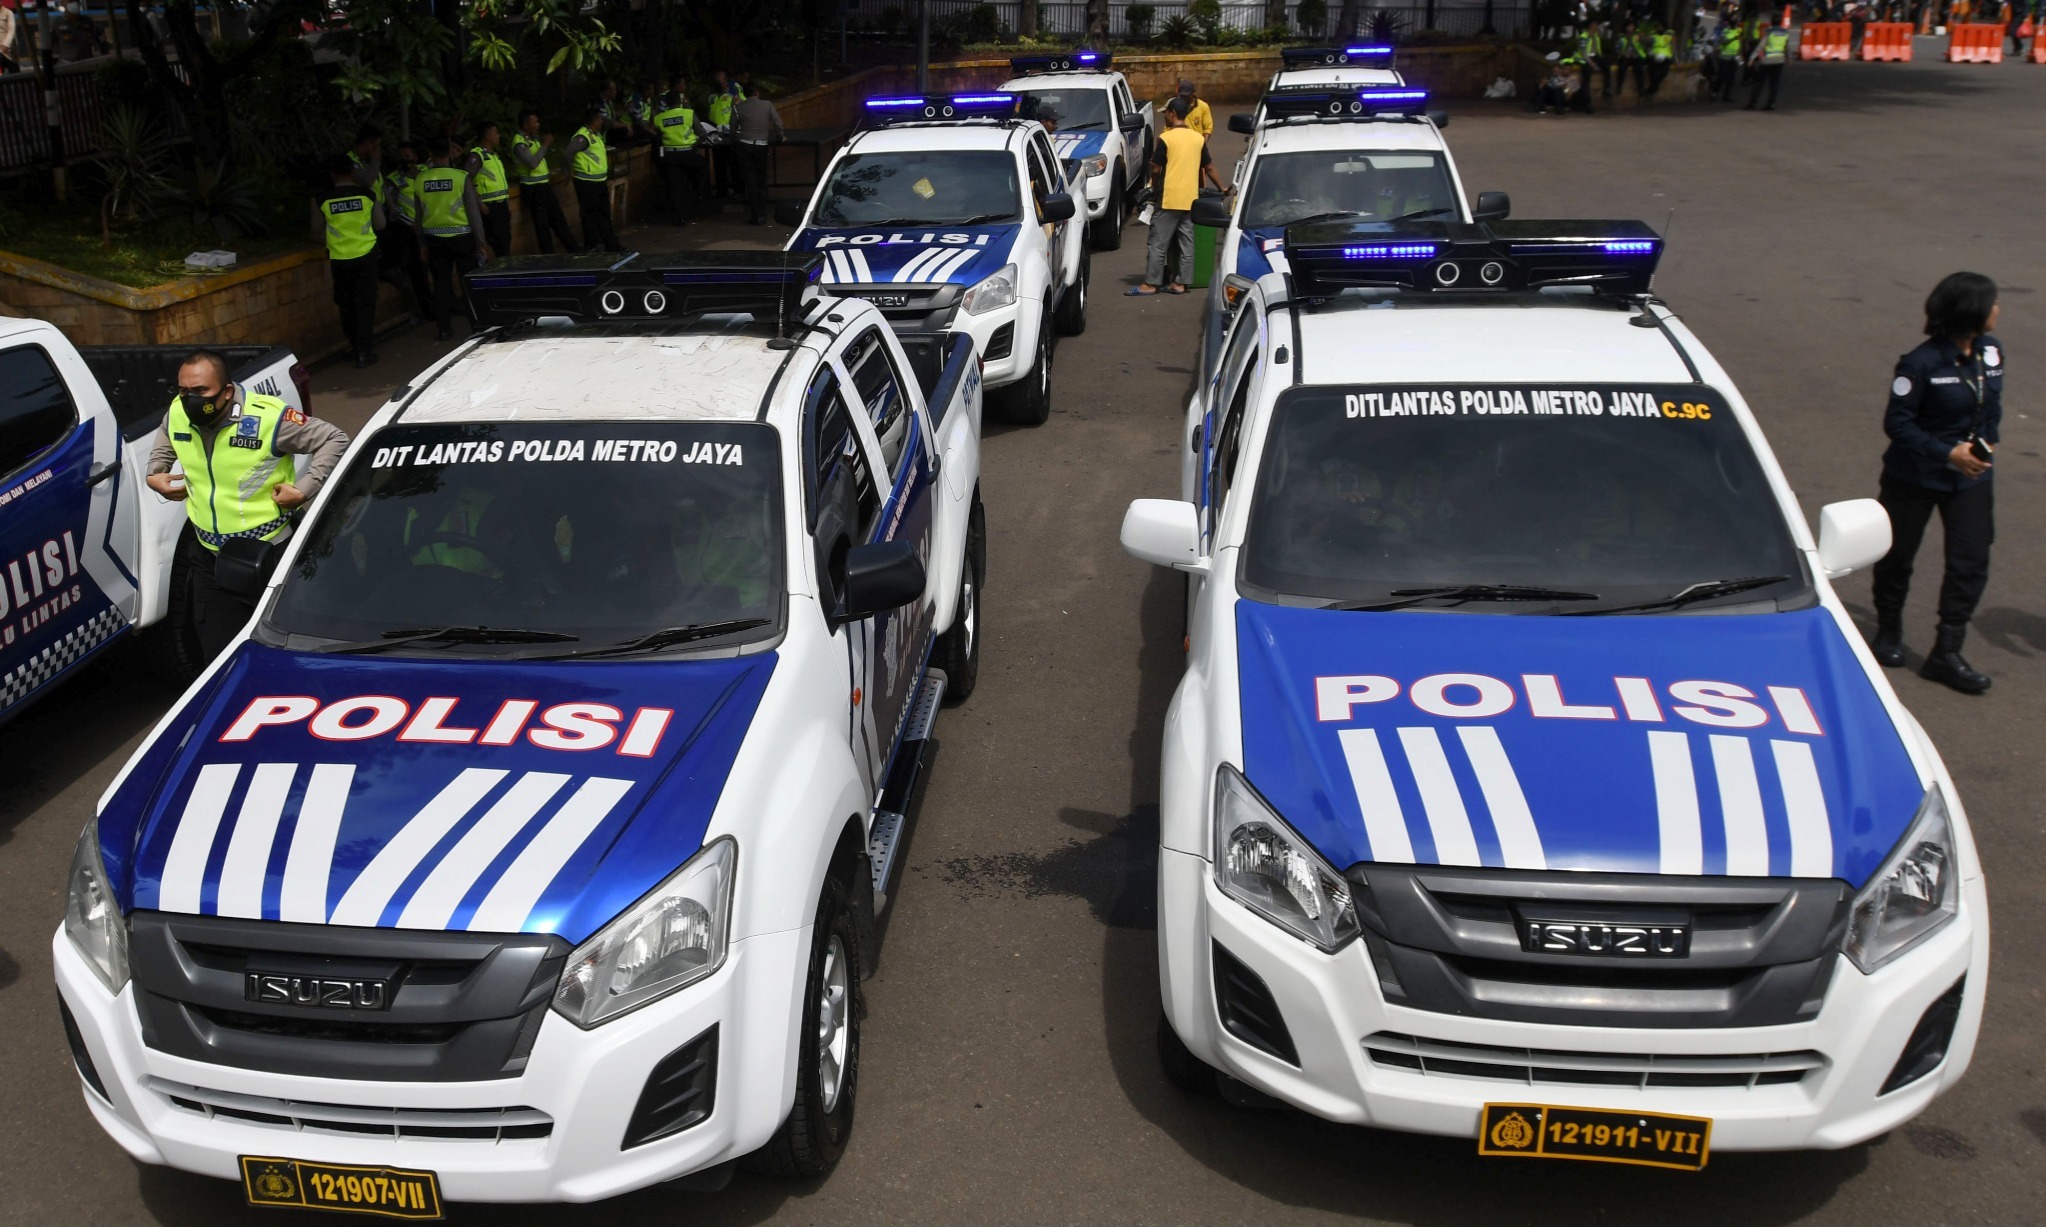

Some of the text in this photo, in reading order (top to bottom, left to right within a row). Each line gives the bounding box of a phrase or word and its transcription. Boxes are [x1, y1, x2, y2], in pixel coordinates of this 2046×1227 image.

[424, 180, 452, 191] POLISI
[331, 200, 362, 213] POLISI
[815, 233, 990, 248] POLISI
[1345, 390, 1712, 420] DITLANTAS POLDA METRO JAYA C.9C
[231, 438, 261, 449] POLISI
[371, 440, 743, 468] DIT LANTAS POLDA METRO JAYA
[22, 585, 82, 635] LINTAS
[1315, 673, 1826, 737] POLISI
[218, 695, 675, 758] POLISI
[1530, 923, 1684, 954] ISUZU
[249, 974, 384, 1010] ISUZU
[1549, 1122, 1701, 1155] 121911-VII
[311, 1172, 426, 1210] 121907-VII
